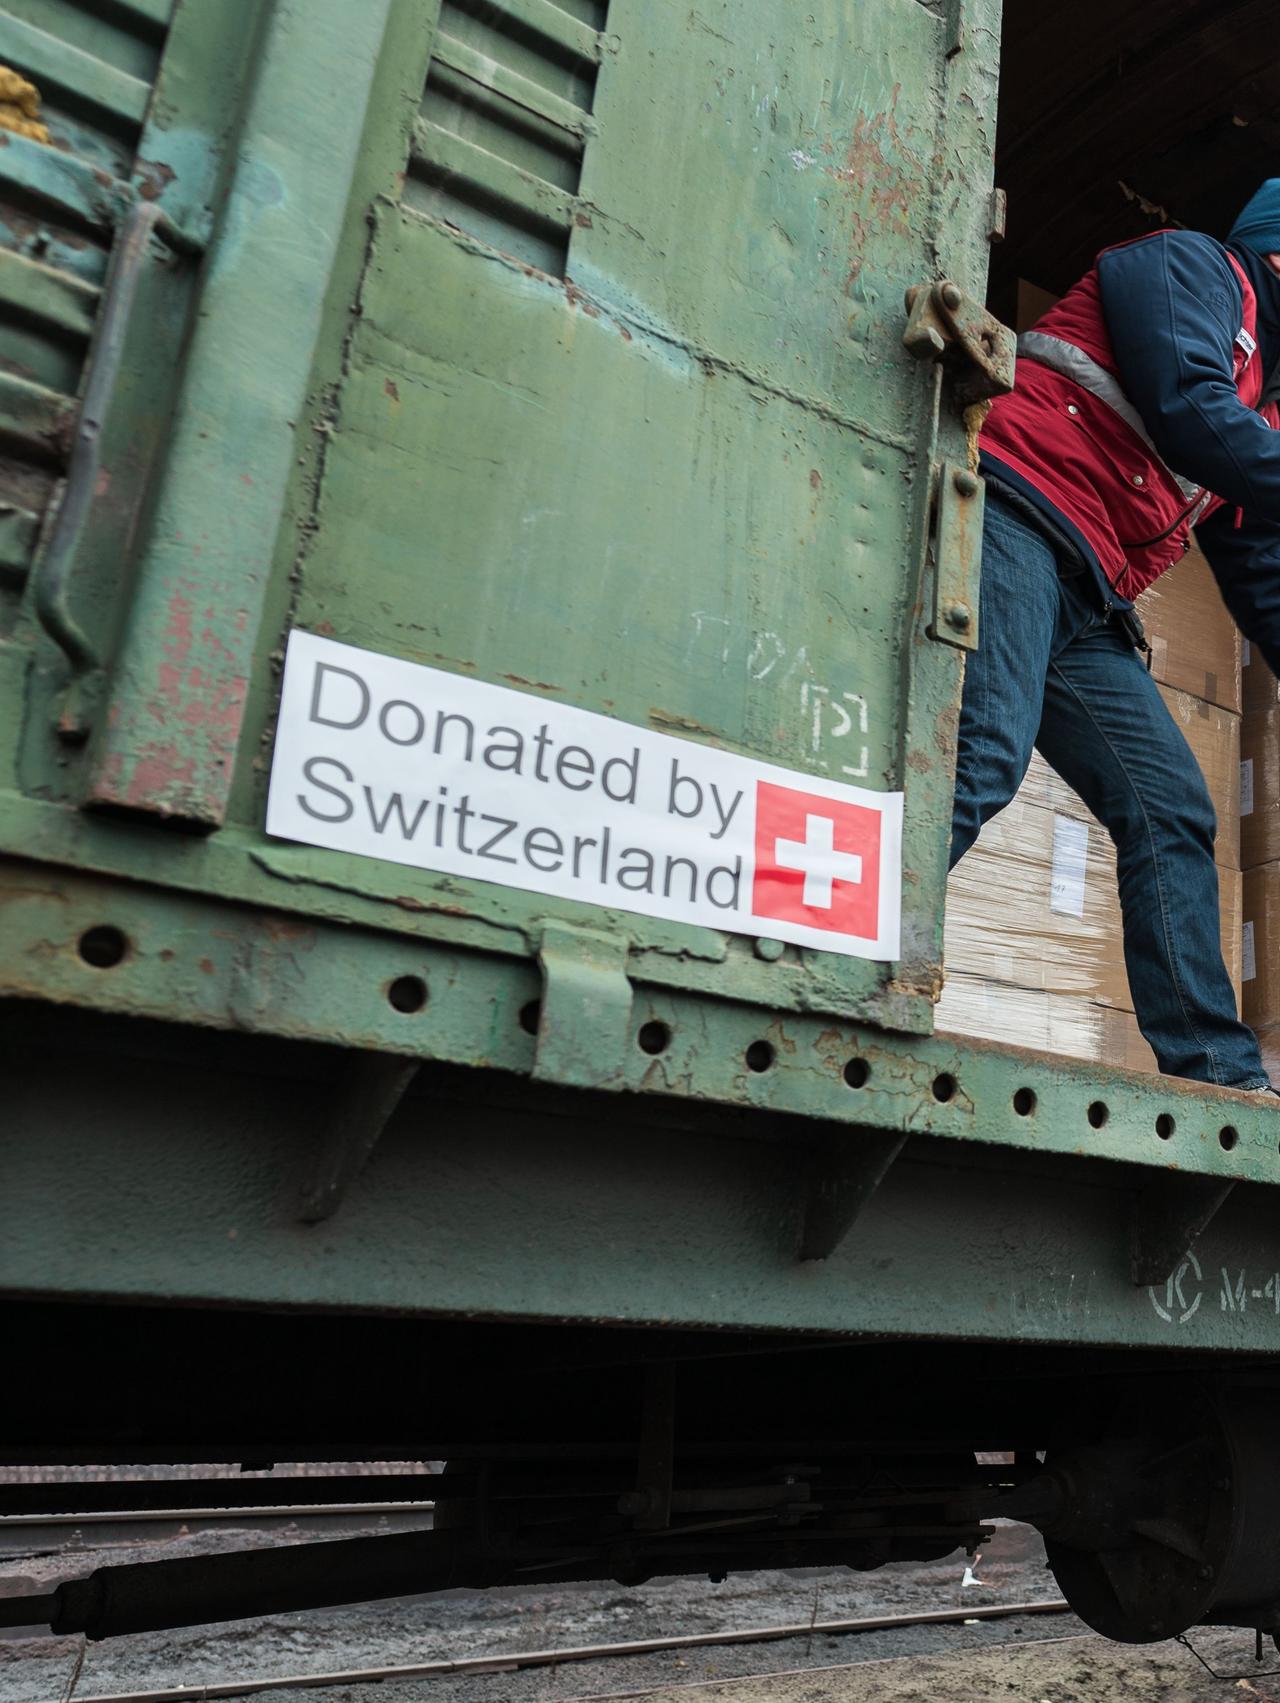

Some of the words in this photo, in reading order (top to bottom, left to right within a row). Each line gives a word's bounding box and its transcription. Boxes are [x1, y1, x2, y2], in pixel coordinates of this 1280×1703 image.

[308, 661, 641, 805] Donated
[668, 758, 744, 839] by
[296, 756, 742, 911] Switzerland
